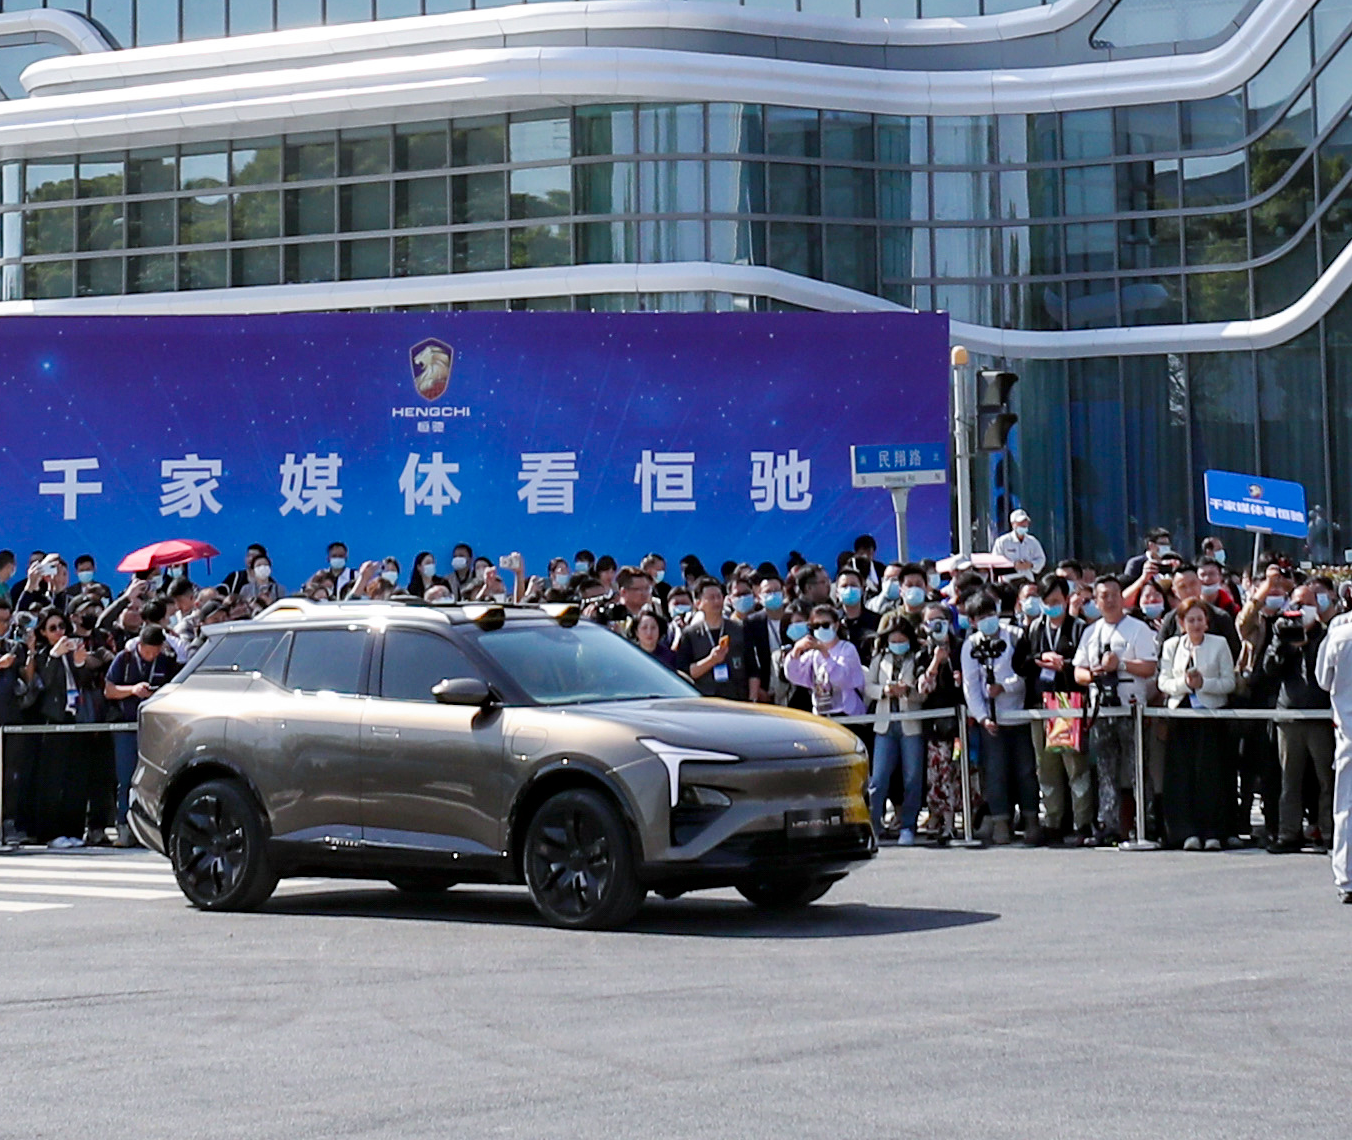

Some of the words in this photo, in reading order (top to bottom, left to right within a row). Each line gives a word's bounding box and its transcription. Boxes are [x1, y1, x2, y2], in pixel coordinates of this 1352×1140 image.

[392, 406, 470, 417] HENGCHI
[39, 449, 813, 520] 千家媒体看恒驰
